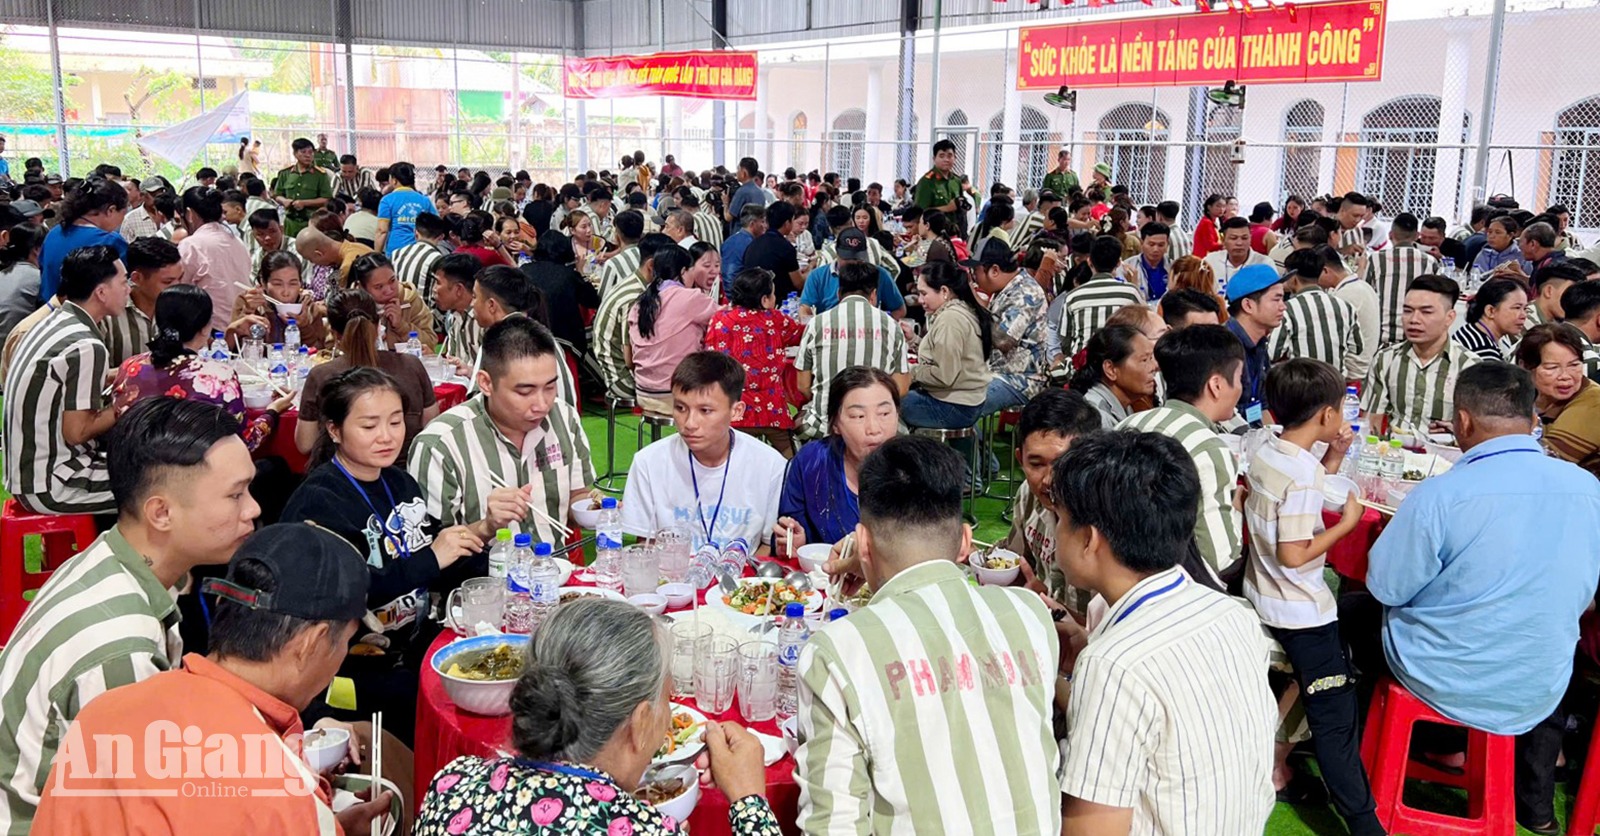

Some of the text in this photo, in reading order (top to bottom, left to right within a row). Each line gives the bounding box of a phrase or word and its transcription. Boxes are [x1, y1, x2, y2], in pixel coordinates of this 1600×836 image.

[1060, 35, 1096, 76] KHỎE
[1100, 37, 1118, 74] LÀ
[1121, 33, 1153, 73] NỀN
[1157, 29, 1198, 71] TẢNG
[1202, 26, 1236, 69] CỦA
[1242, 27, 1302, 68] THÀNH
[884, 654, 974, 700] PHAM
